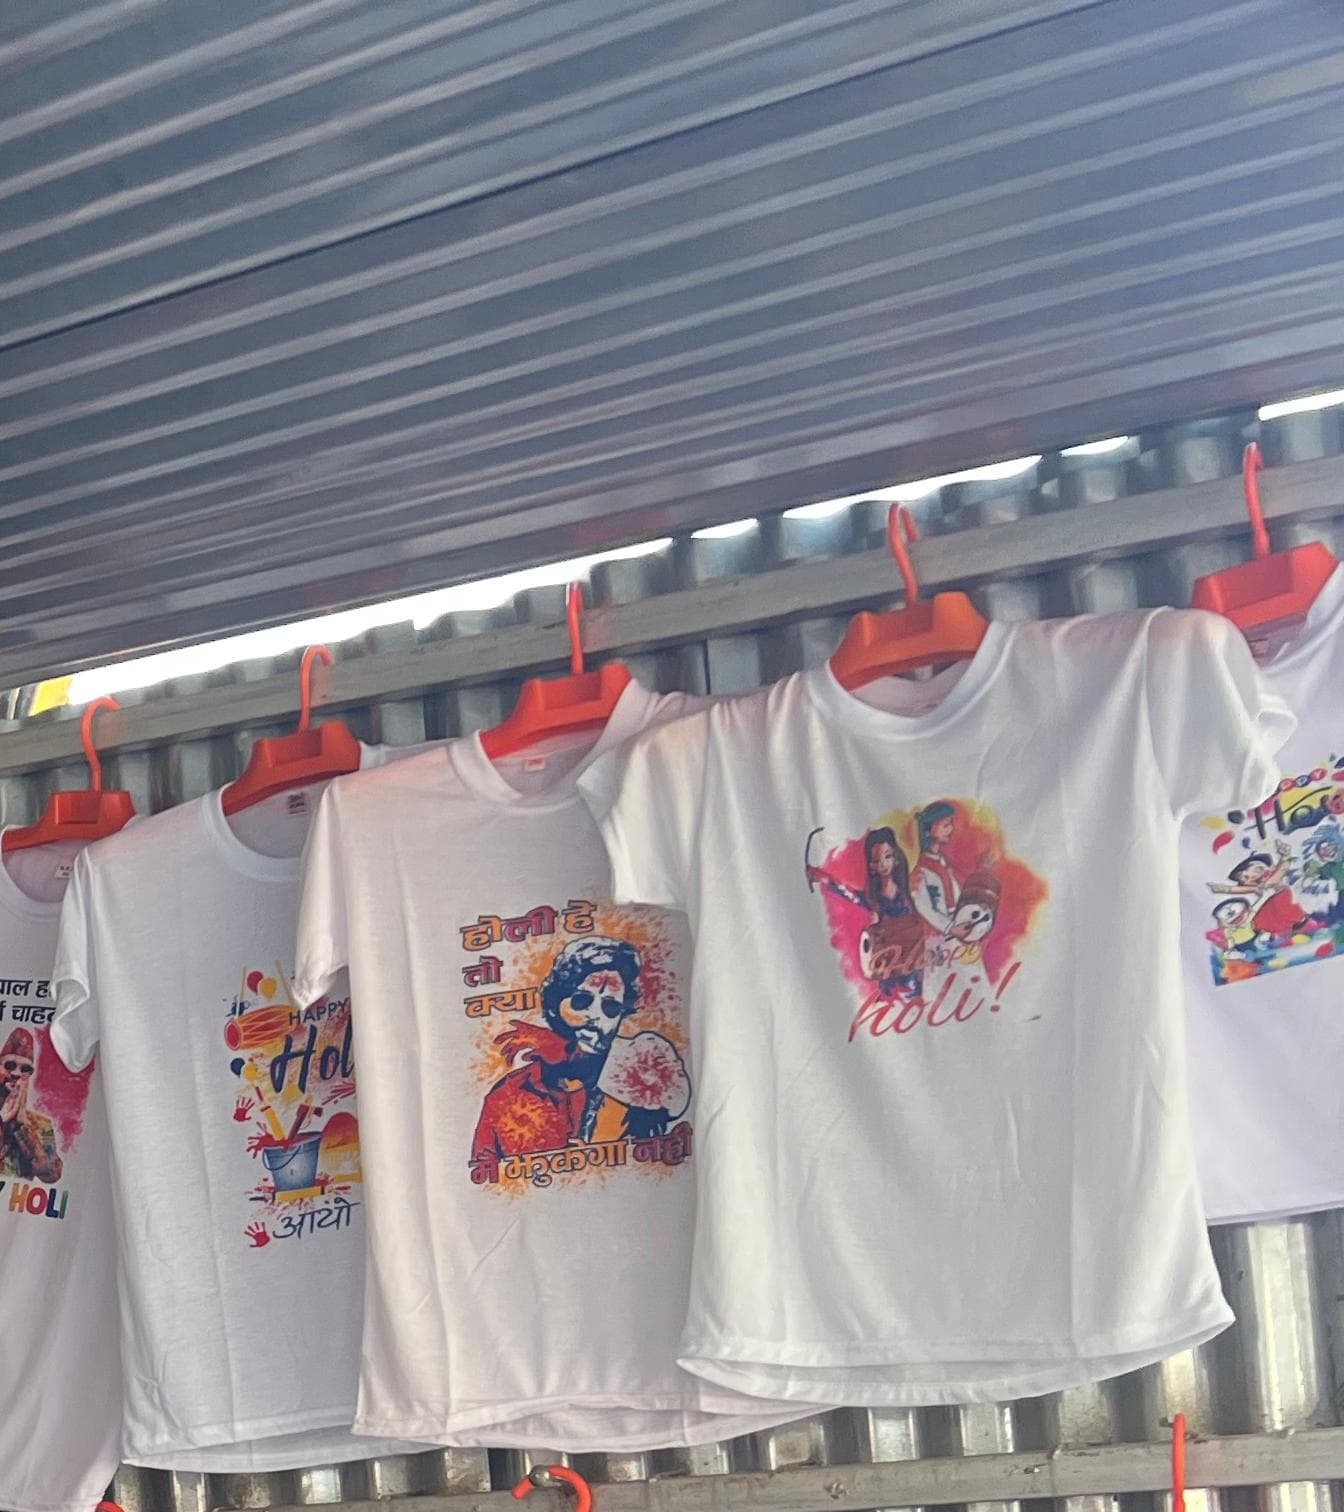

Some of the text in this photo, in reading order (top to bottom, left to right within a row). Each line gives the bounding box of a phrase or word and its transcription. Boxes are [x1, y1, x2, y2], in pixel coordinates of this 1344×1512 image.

[459, 905, 558, 952] होली
[462, 955, 503, 987] तो
[464, 987, 538, 1018] क्या
[8, 1183, 69, 1220] HOLI
